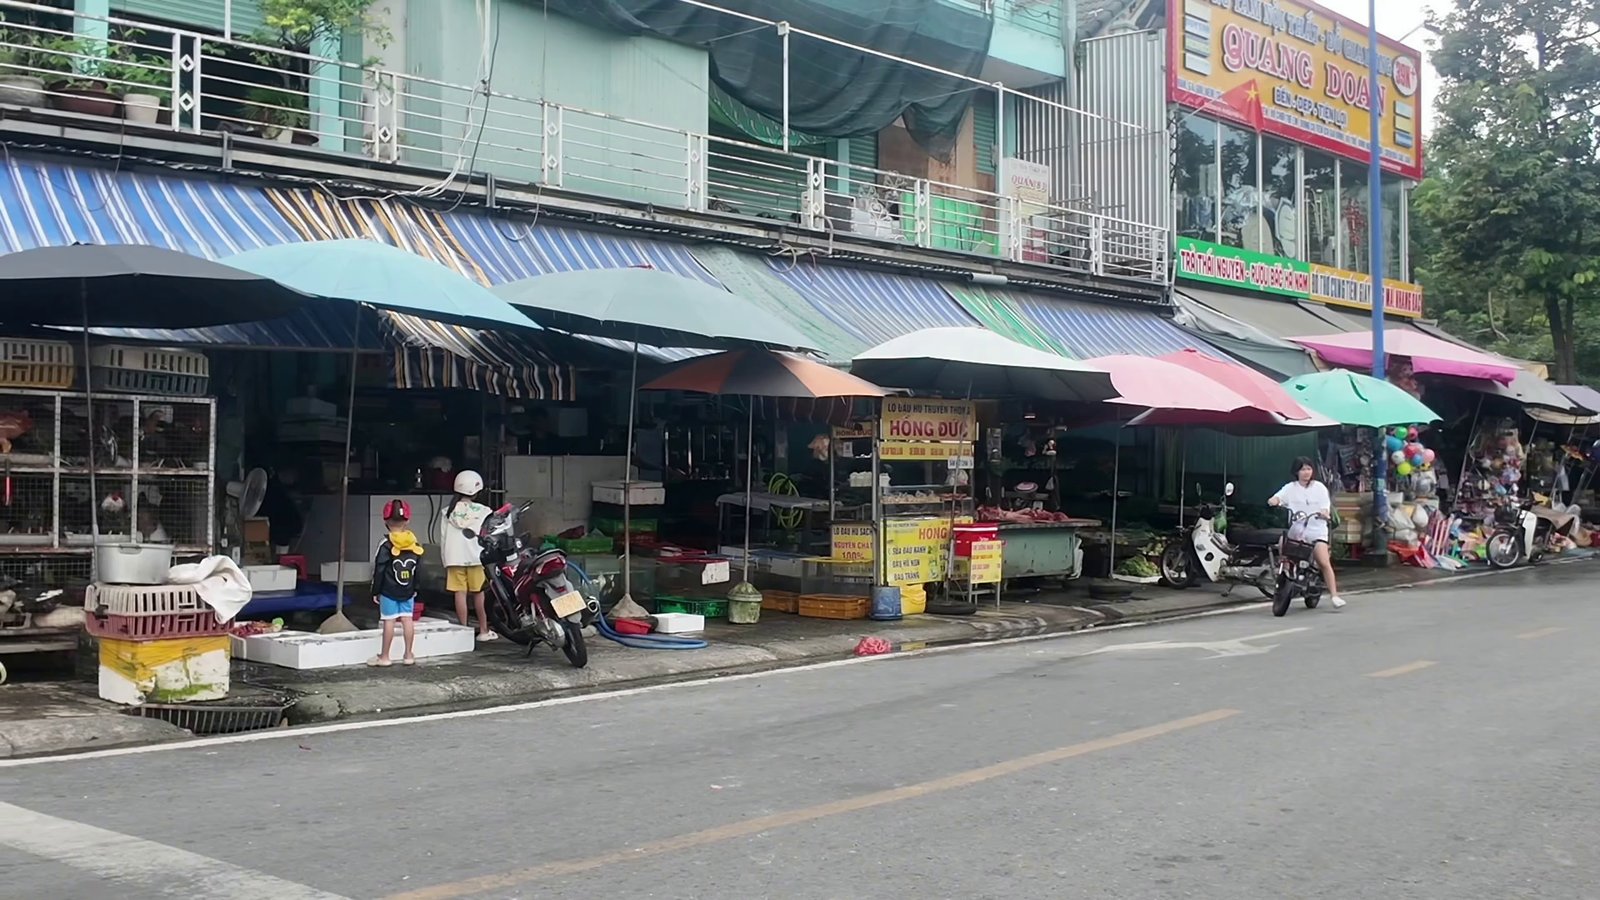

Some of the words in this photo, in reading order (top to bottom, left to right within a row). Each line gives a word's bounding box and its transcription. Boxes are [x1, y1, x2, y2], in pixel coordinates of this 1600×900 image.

[1223, 23, 1314, 88] QUANG
[1180, 243, 1196, 273] TRÀ
[1197, 248, 1215, 277] THÁI
[1215, 255, 1245, 282] NGUYÊN
